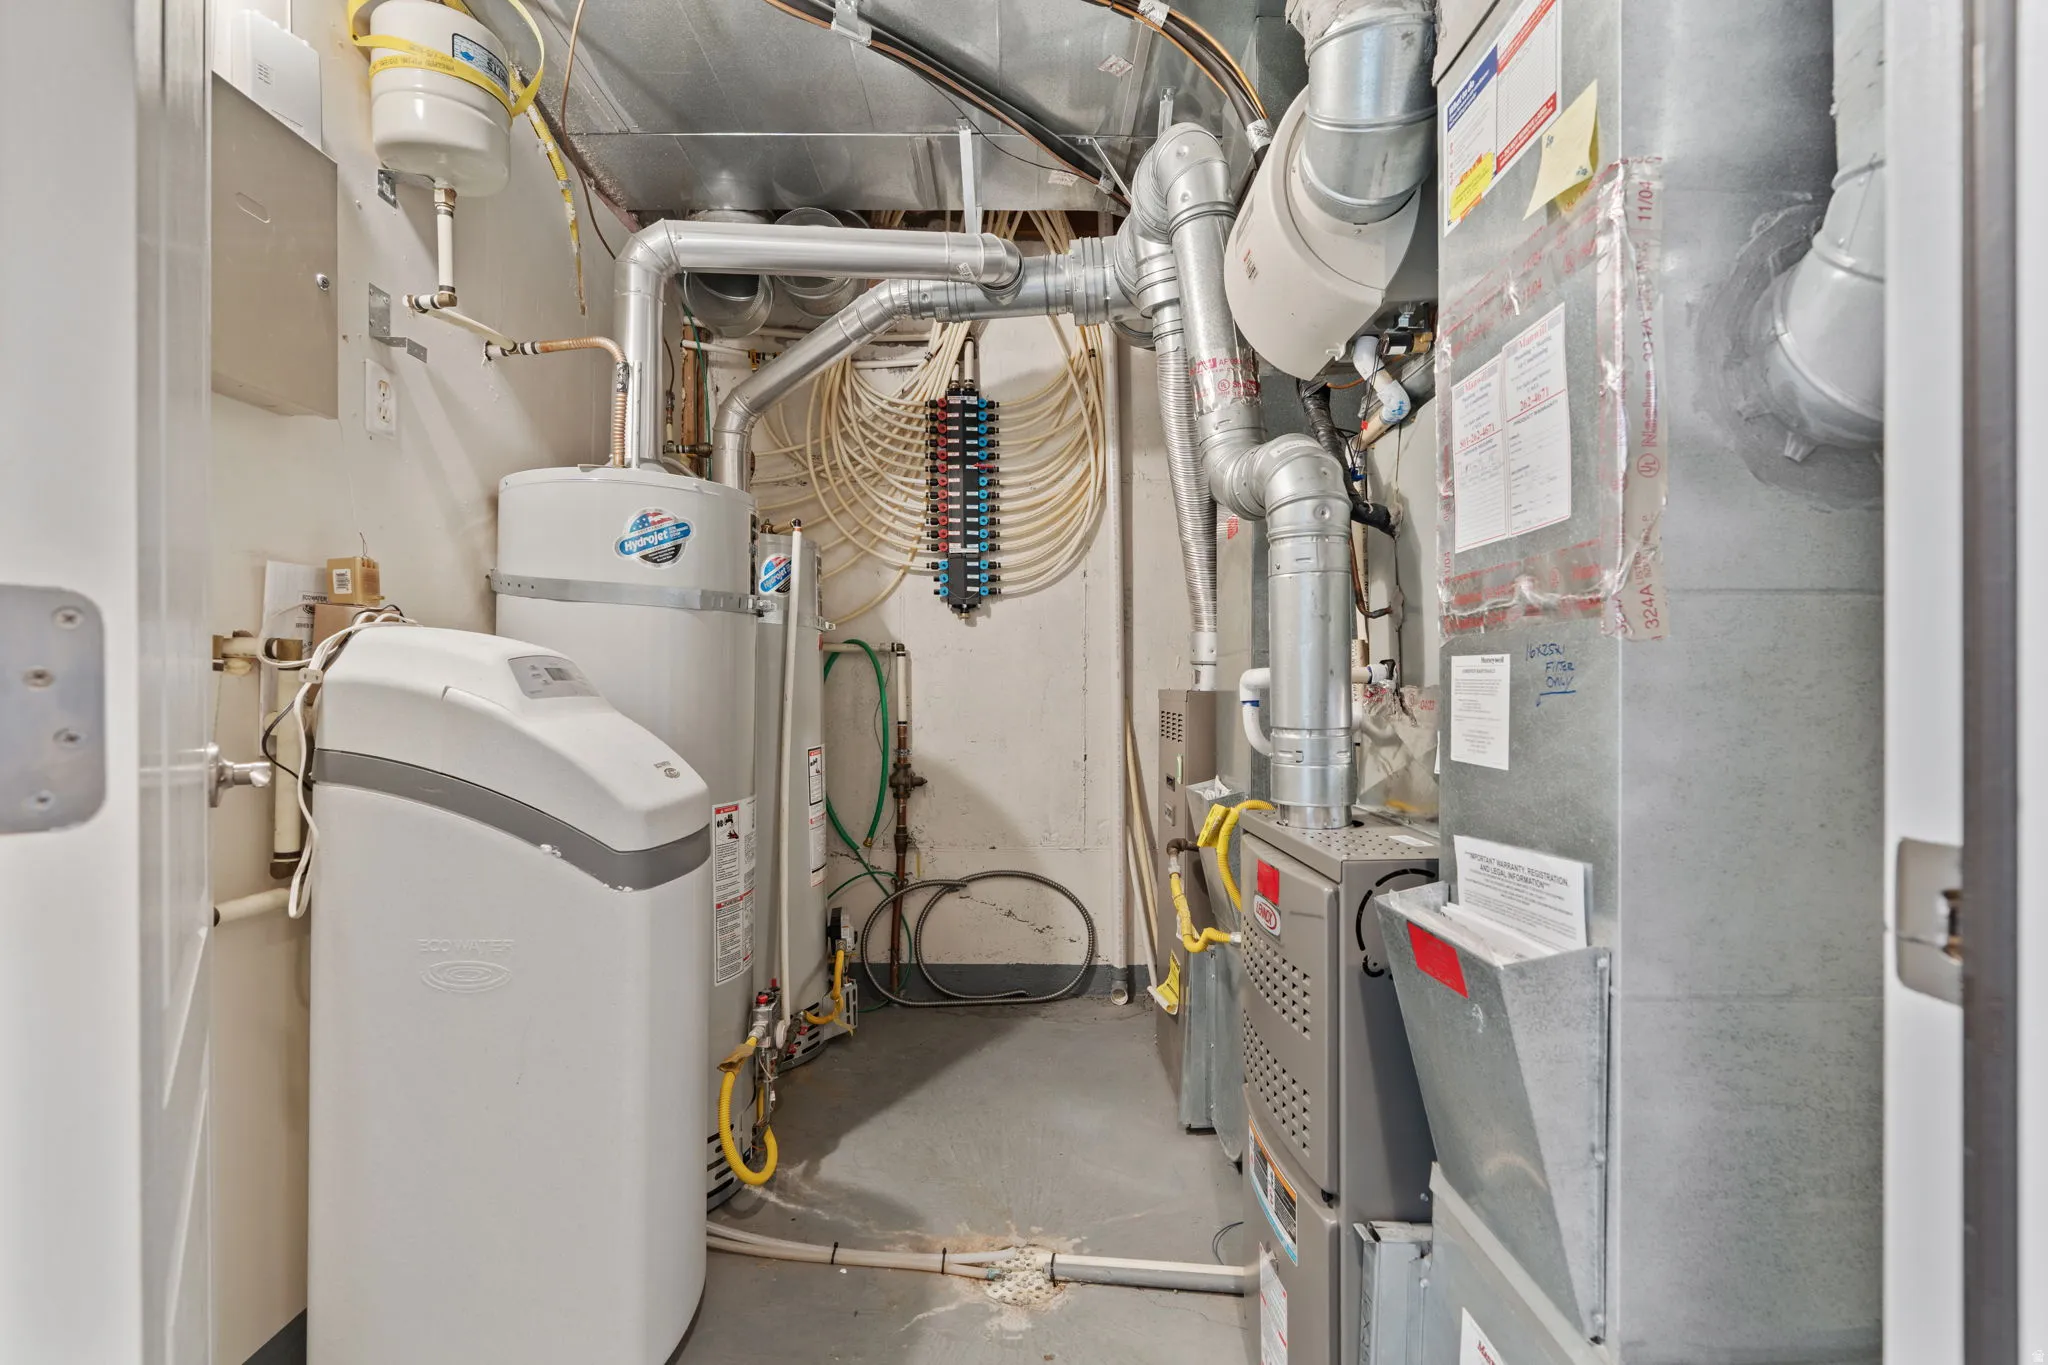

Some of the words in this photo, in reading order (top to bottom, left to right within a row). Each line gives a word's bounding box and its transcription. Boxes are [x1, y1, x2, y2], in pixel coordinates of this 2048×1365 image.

[1637, 182, 1653, 221] 11/04
[624, 530, 669, 552] Hydrojet
[1639, 583, 1660, 630] 324A
[1256, 901, 1273, 926] LENNOX
[416, 937, 516, 953] ECOWATER
